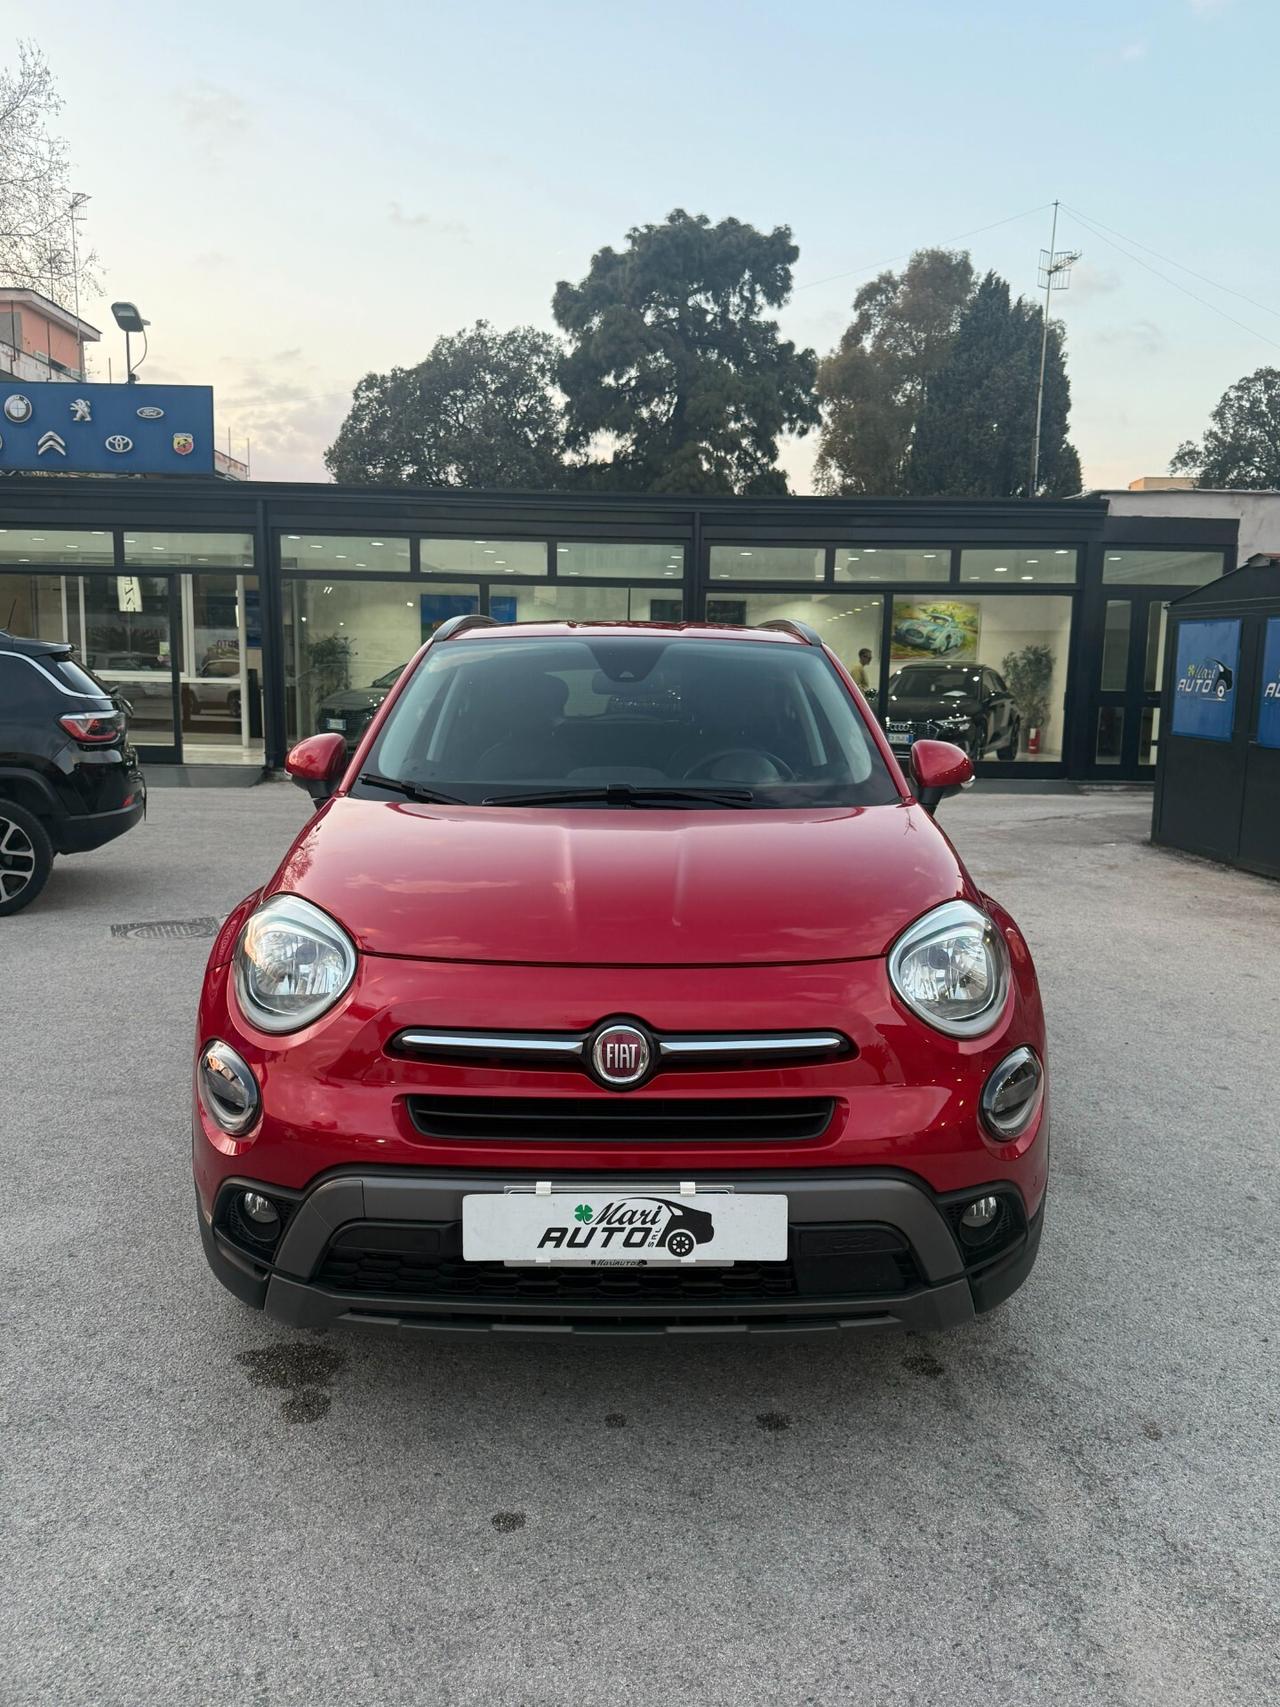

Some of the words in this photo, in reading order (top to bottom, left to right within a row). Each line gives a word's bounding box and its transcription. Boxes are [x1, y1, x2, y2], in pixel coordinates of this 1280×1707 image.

[1177, 679, 1212, 693] AUTO
[607, 1043, 638, 1069] FIAT
[583, 1202, 663, 1225] Mari
[537, 1227, 653, 1248] AUTO
[647, 1228, 662, 1248] SRL
